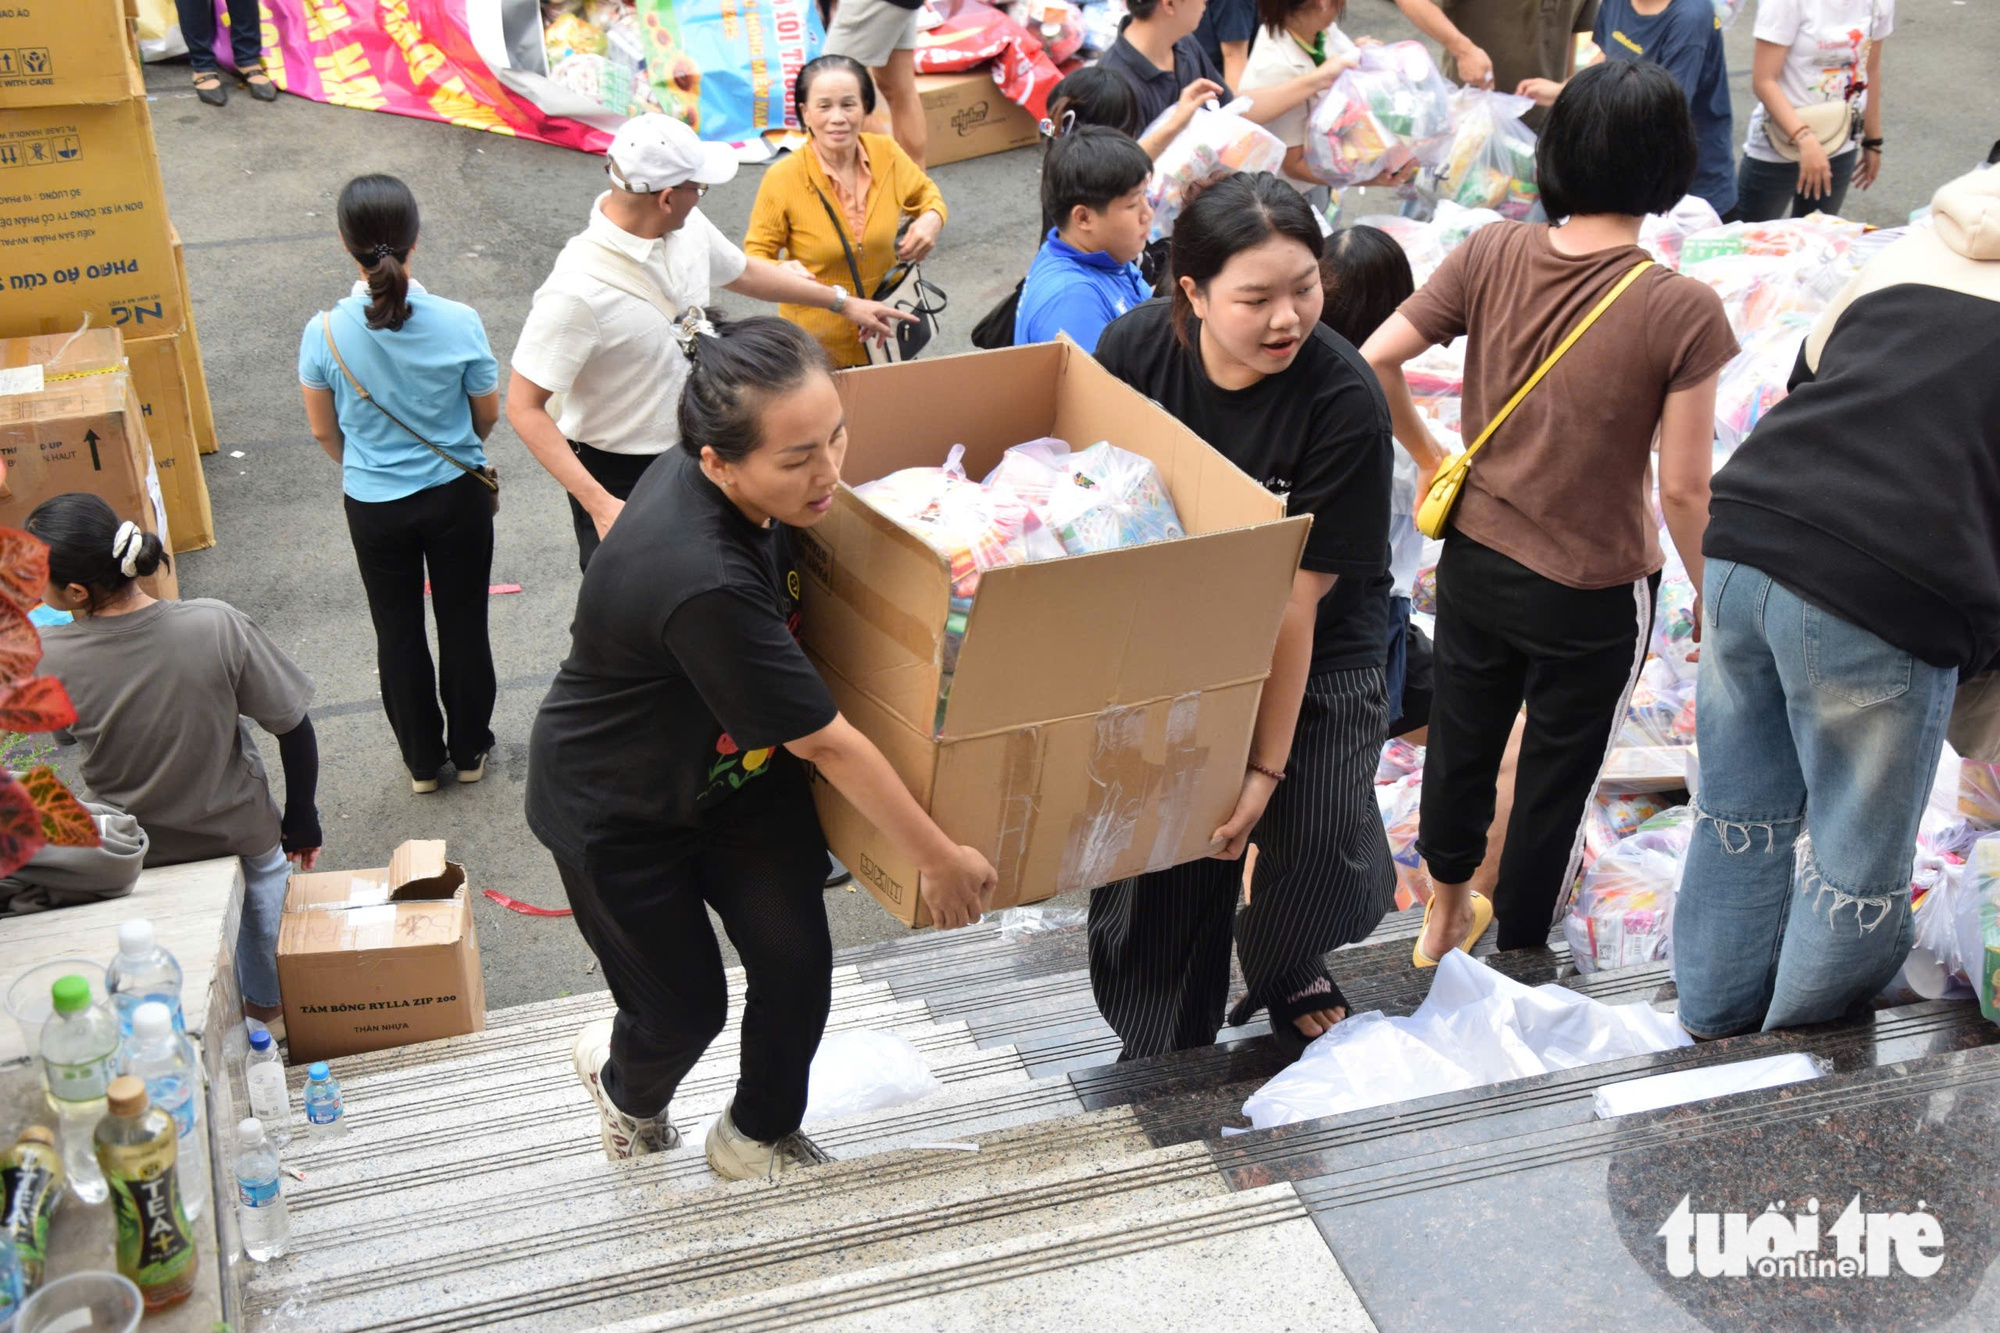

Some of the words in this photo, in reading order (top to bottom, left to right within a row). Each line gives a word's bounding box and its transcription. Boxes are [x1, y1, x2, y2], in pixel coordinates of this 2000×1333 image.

[5, 79, 27, 87] WITH
[29, 78, 54, 86] CARE
[57, 212, 68, 220] TY
[86, 259, 139, 279] PHAO
[49, 441, 63, 450] UP
[51, 451, 77, 462] HAUT
[369, 1000, 410, 1011] RYLLA
[413, 997, 433, 1006] ZIP
[437, 995, 457, 1003] 200
[382, 1022, 410, 1031] NHỰA
